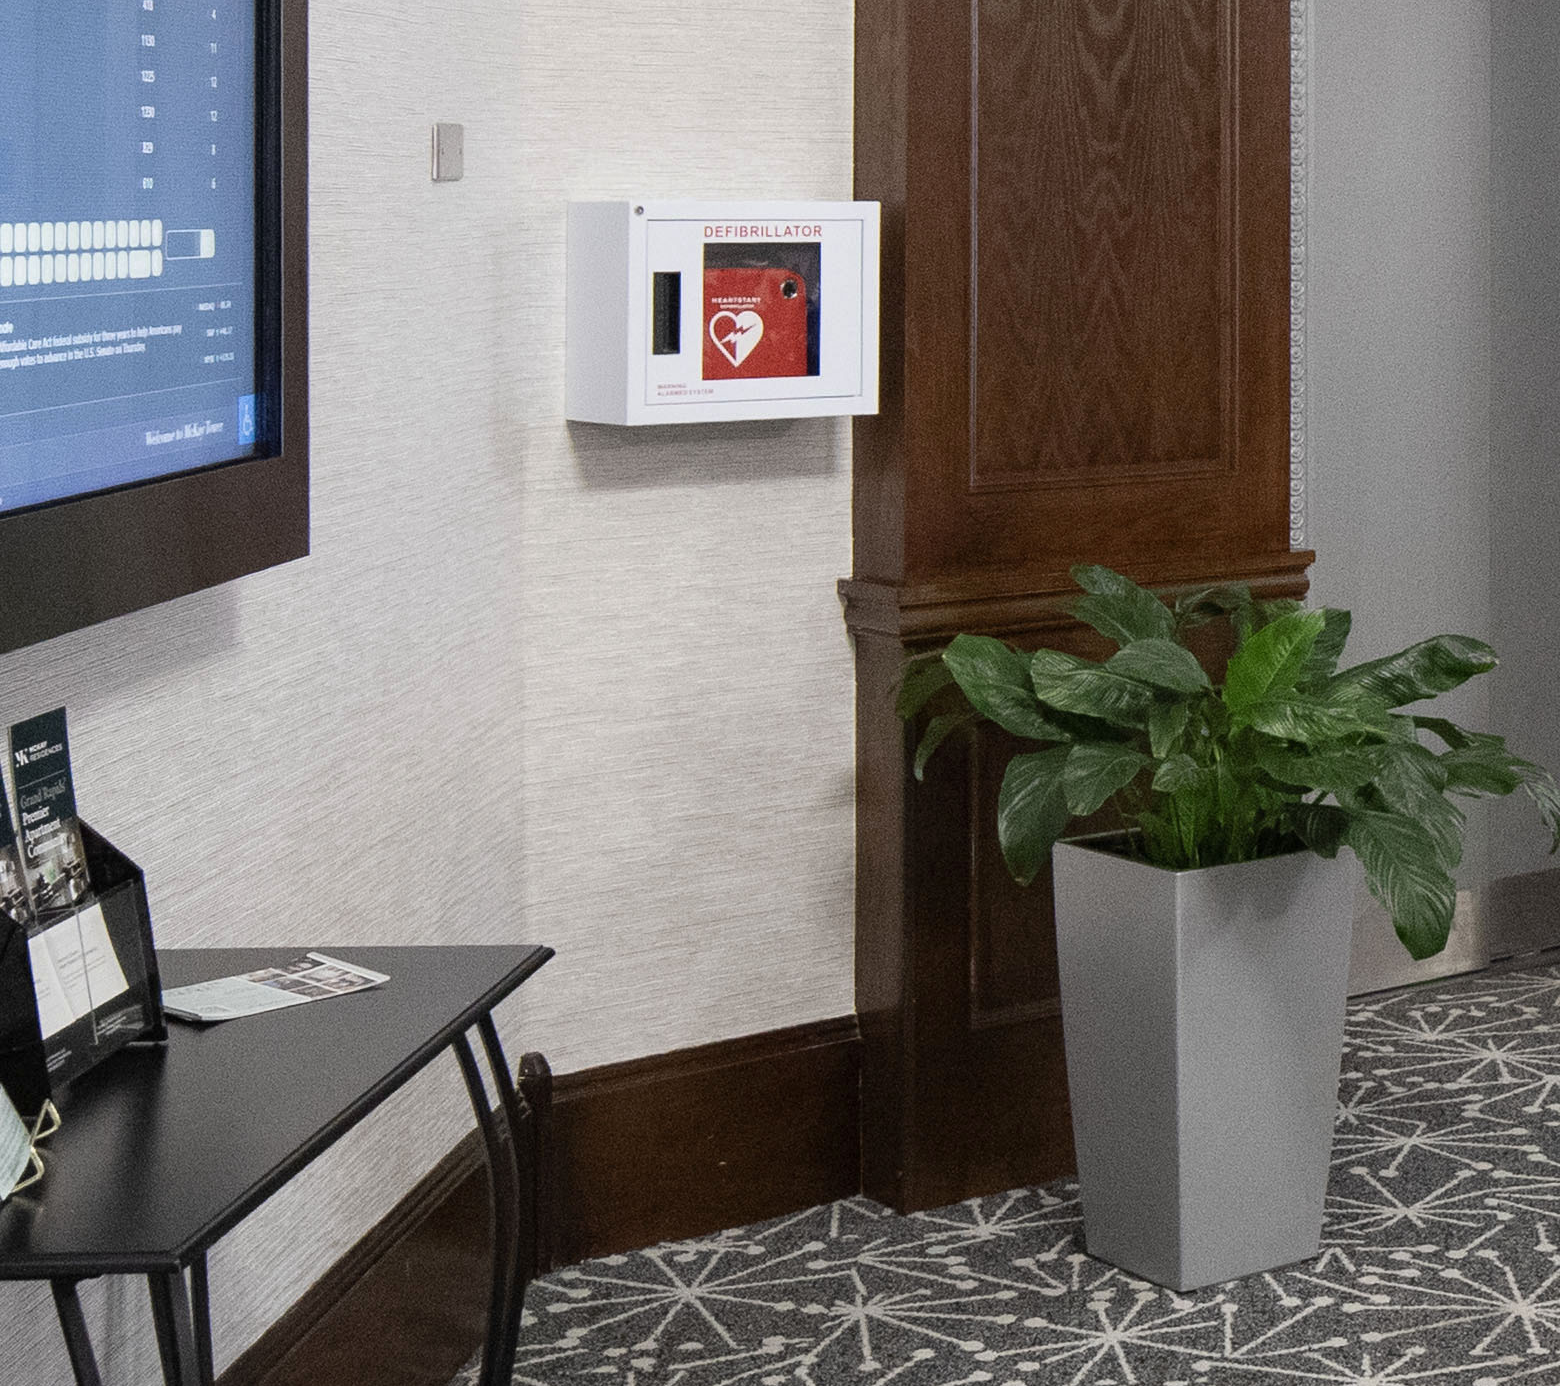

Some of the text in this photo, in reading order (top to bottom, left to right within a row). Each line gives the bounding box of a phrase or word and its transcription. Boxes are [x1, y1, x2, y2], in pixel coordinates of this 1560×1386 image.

[704, 225, 823, 238] DEFIBRILLATOR
[20, 790, 42, 810] Grand
[21, 806, 50, 826] Premier
[25, 817, 62, 845] Apartment
